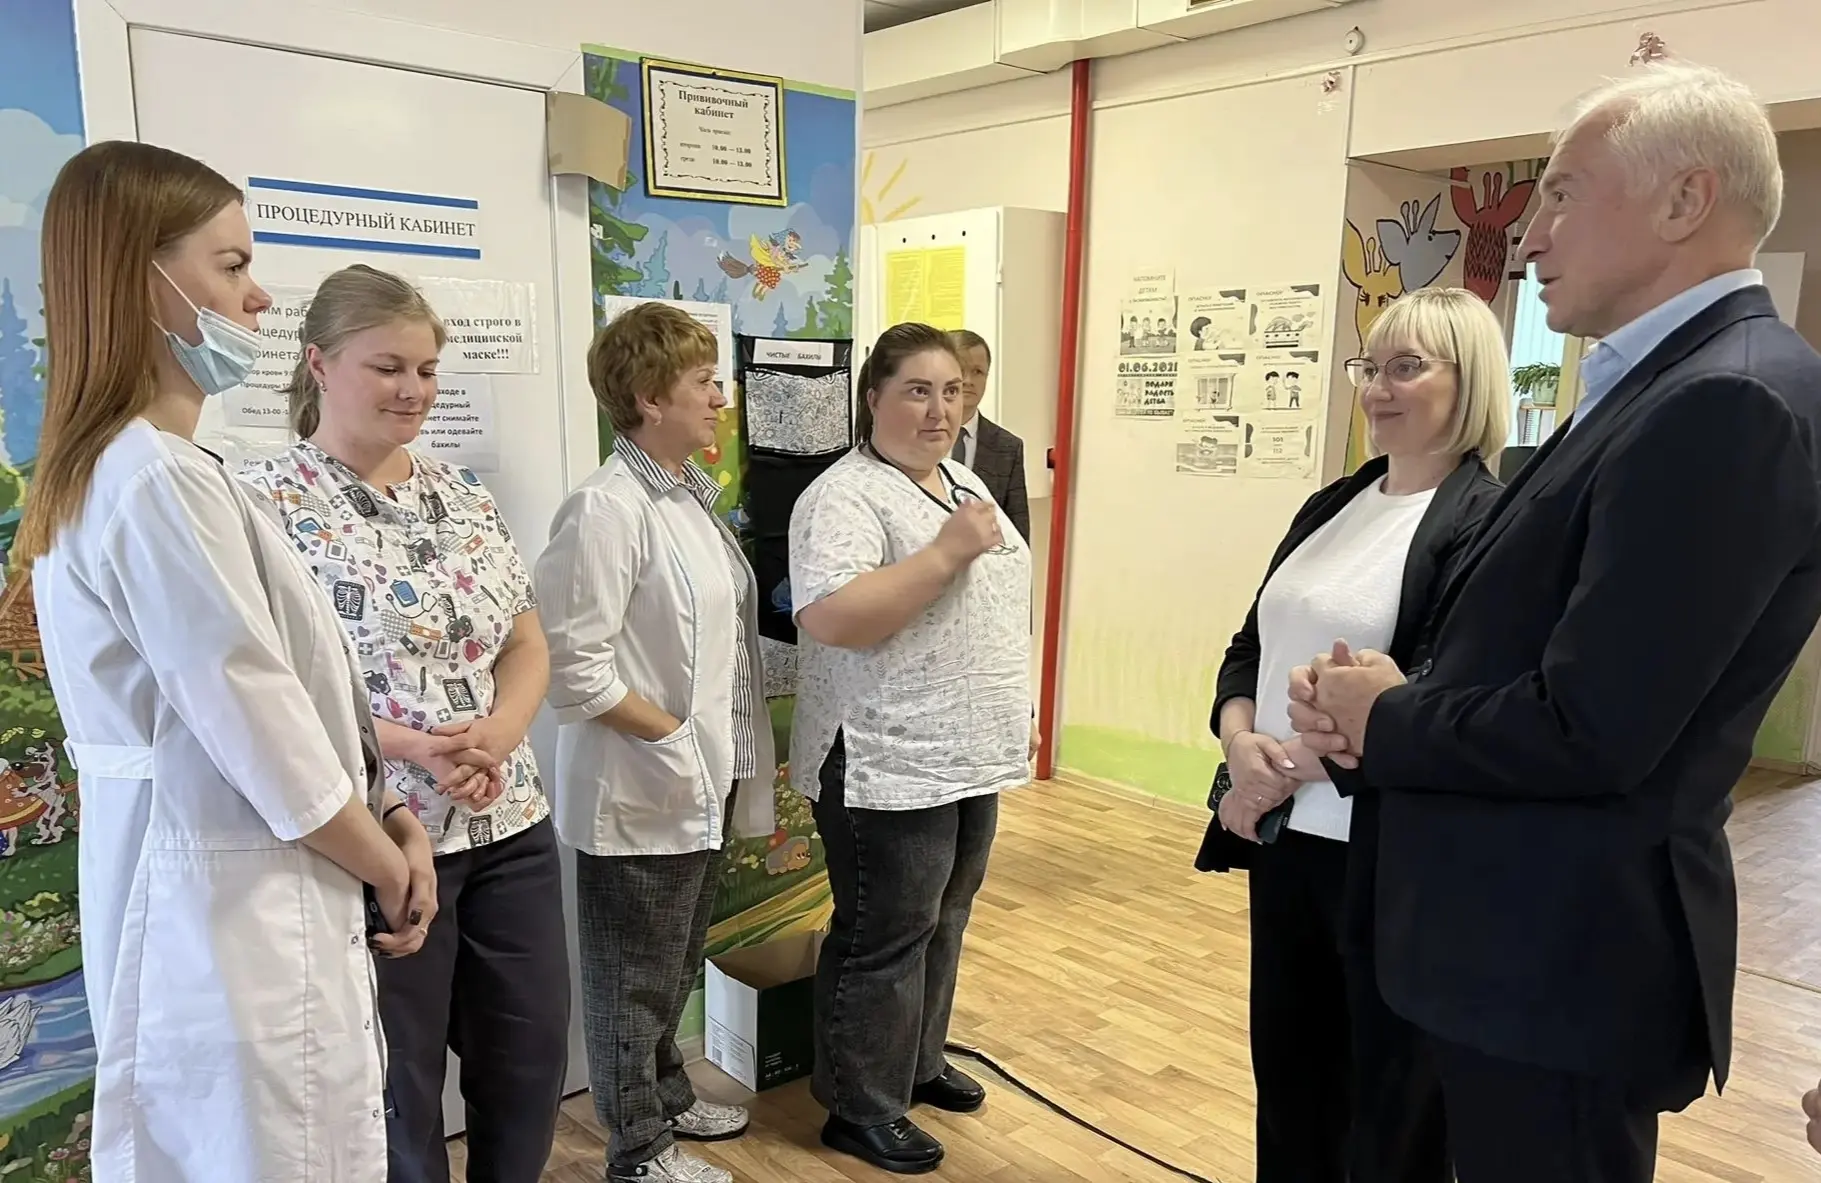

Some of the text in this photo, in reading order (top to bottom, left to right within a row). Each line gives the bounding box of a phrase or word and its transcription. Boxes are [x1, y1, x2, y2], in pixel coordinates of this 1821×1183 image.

[678, 90, 748, 108] Прививочный
[694, 106, 734, 119] кабинет
[257, 204, 475, 237] ПРОЦЕДУРНЫЙ КАБИНЕТ
[473, 318, 511, 329] строго
[515, 319, 521, 327] в
[258, 328, 300, 340] цедур
[463, 348, 509, 359] маске!!!
[766, 351, 791, 359] ЧИСТЫЕ
[1118, 361, 1178, 372] 01.06.2021
[242, 407, 261, 415] Обед
[442, 414, 479, 422] снимайте
[447, 428, 483, 436] одевайте
